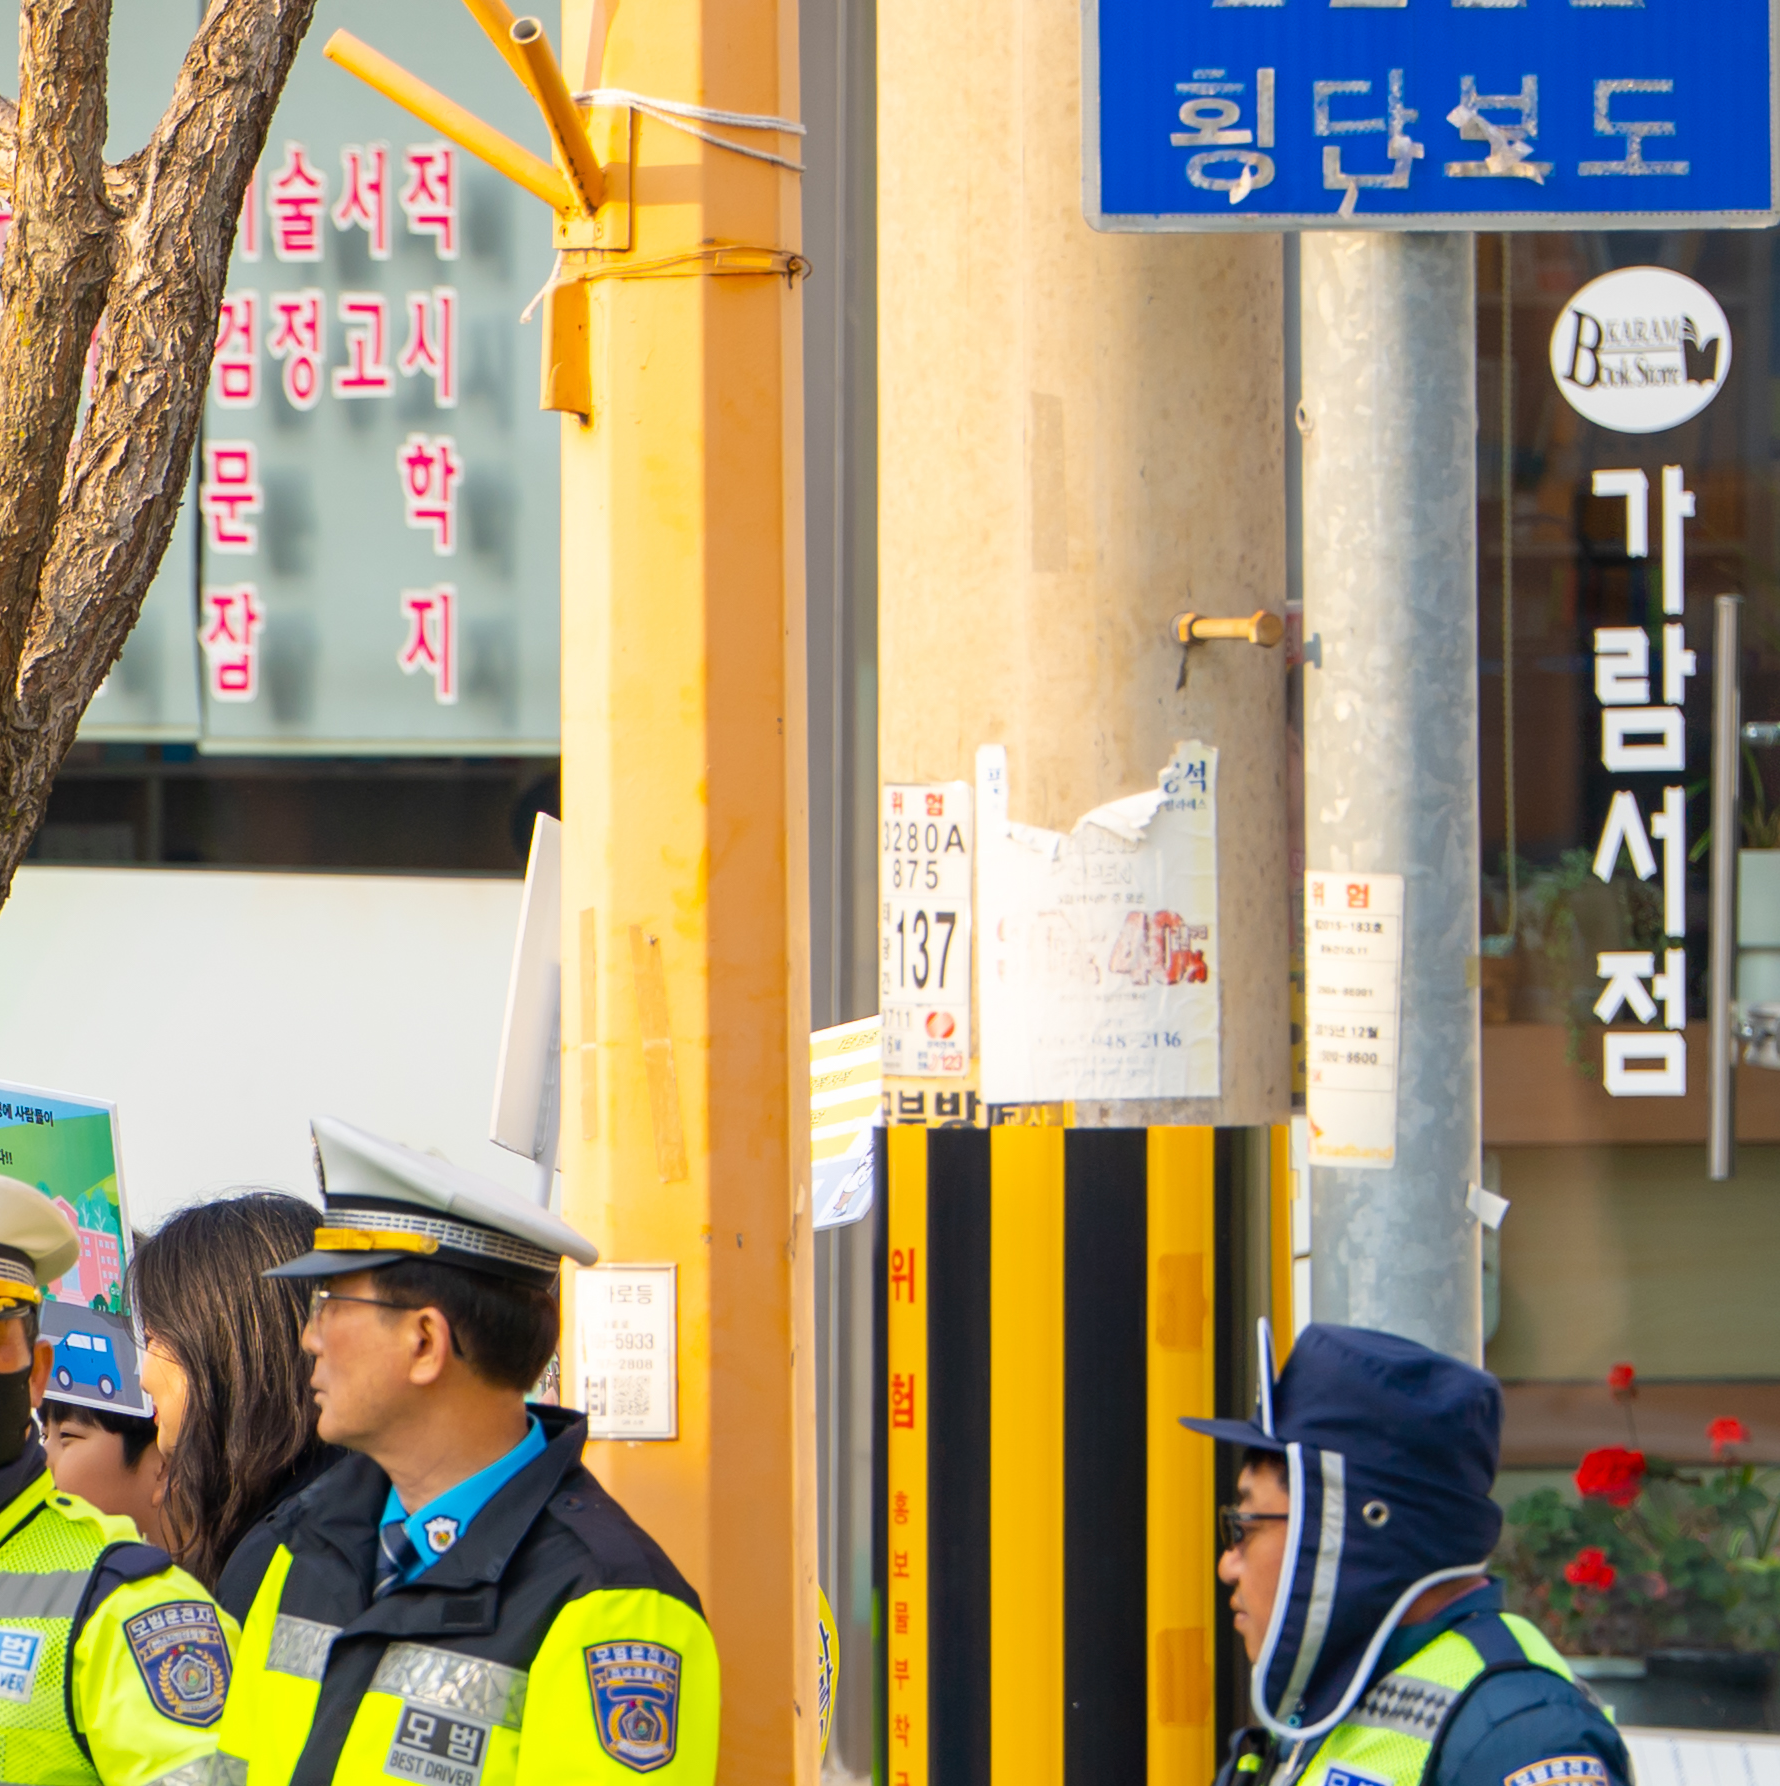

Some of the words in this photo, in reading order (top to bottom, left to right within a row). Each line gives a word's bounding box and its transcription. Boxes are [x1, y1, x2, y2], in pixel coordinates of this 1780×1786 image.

[1170, 67, 1690, 190] 횡단보도
[217, 296, 456, 405] 검정고시
[1591, 464, 1696, 1097] 가람서점
[893, 858, 939, 890] 875
[896, 909, 957, 989] 137
[14, 1105, 55, 1128] 사람들이
[130, 1606, 212, 1639] 모범운전자
[388, 1749, 424, 1775] BEST
[401, 1711, 480, 1764] 모범
